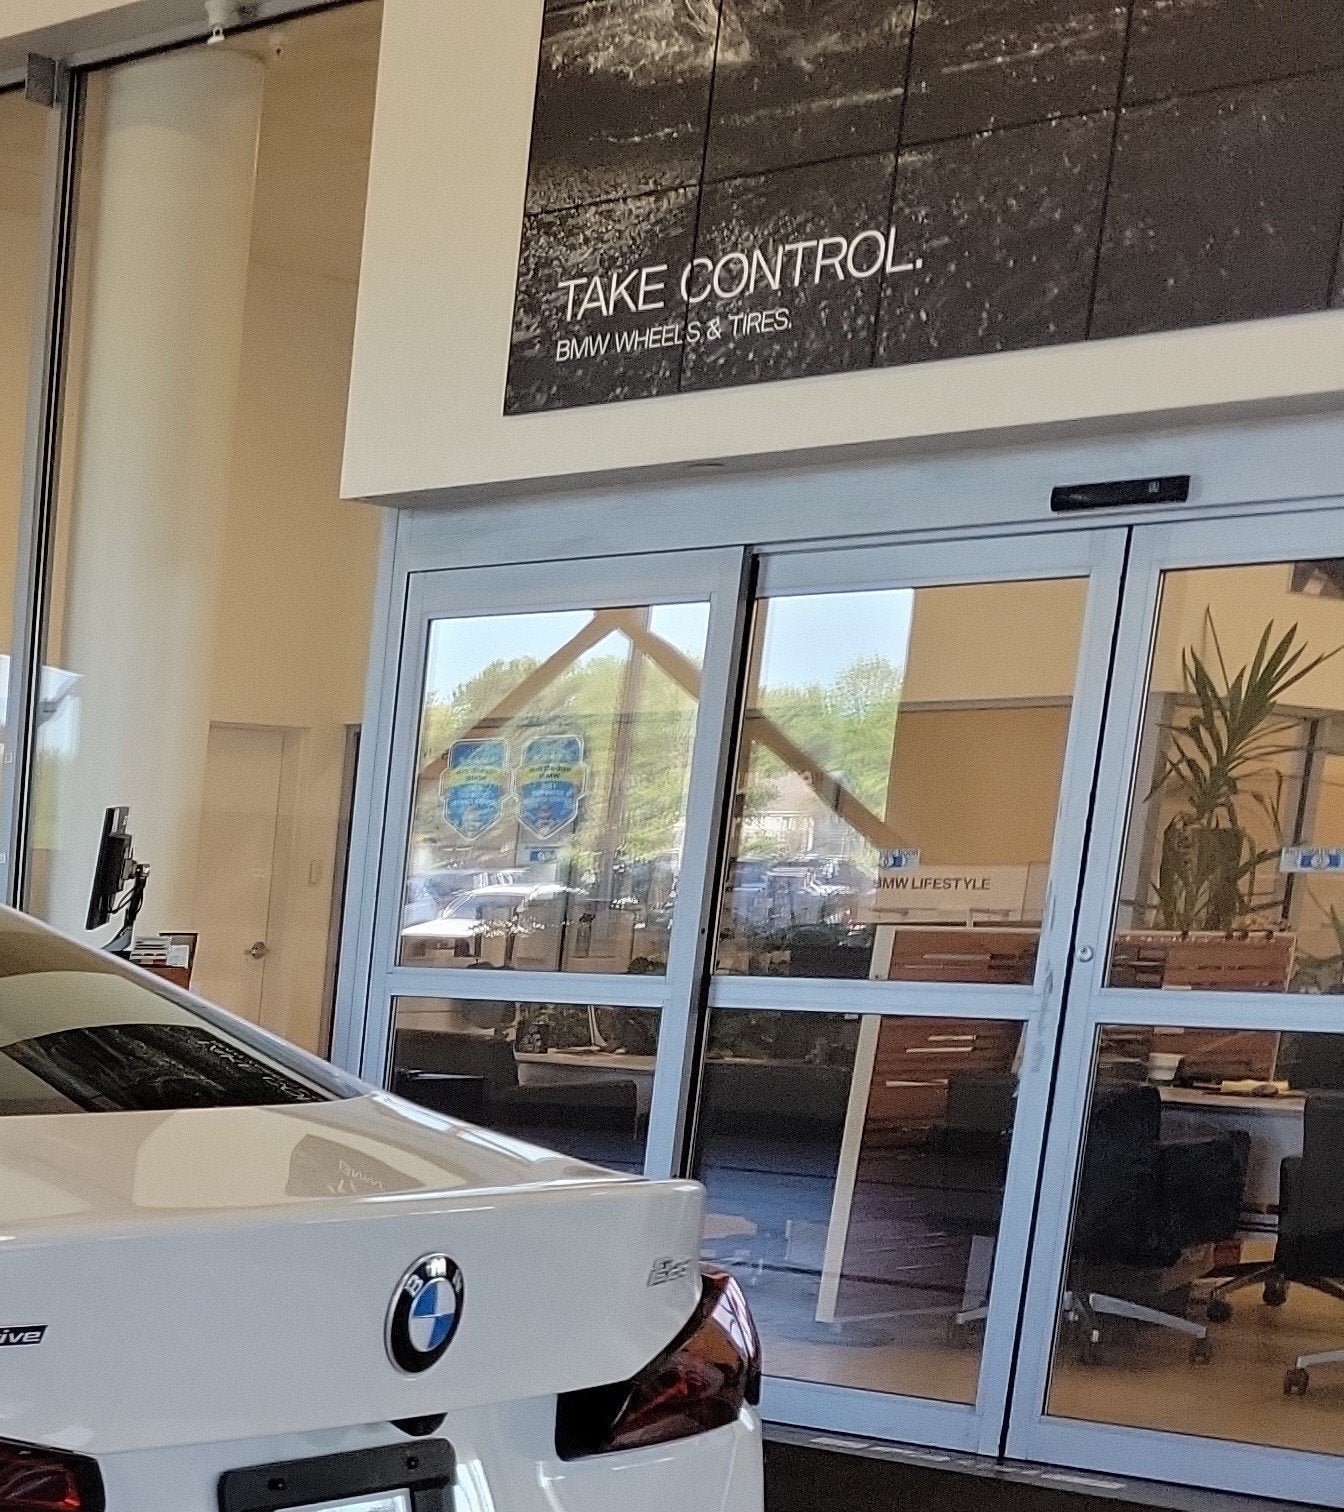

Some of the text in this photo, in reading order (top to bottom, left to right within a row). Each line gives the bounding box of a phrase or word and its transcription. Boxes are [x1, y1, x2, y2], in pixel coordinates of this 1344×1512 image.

[558, 226, 924, 322] TAKE CONTROL.
[555, 308, 793, 363] BMW WHEELS & TIRES.
[911, 877, 991, 890] LIFESTYLE
